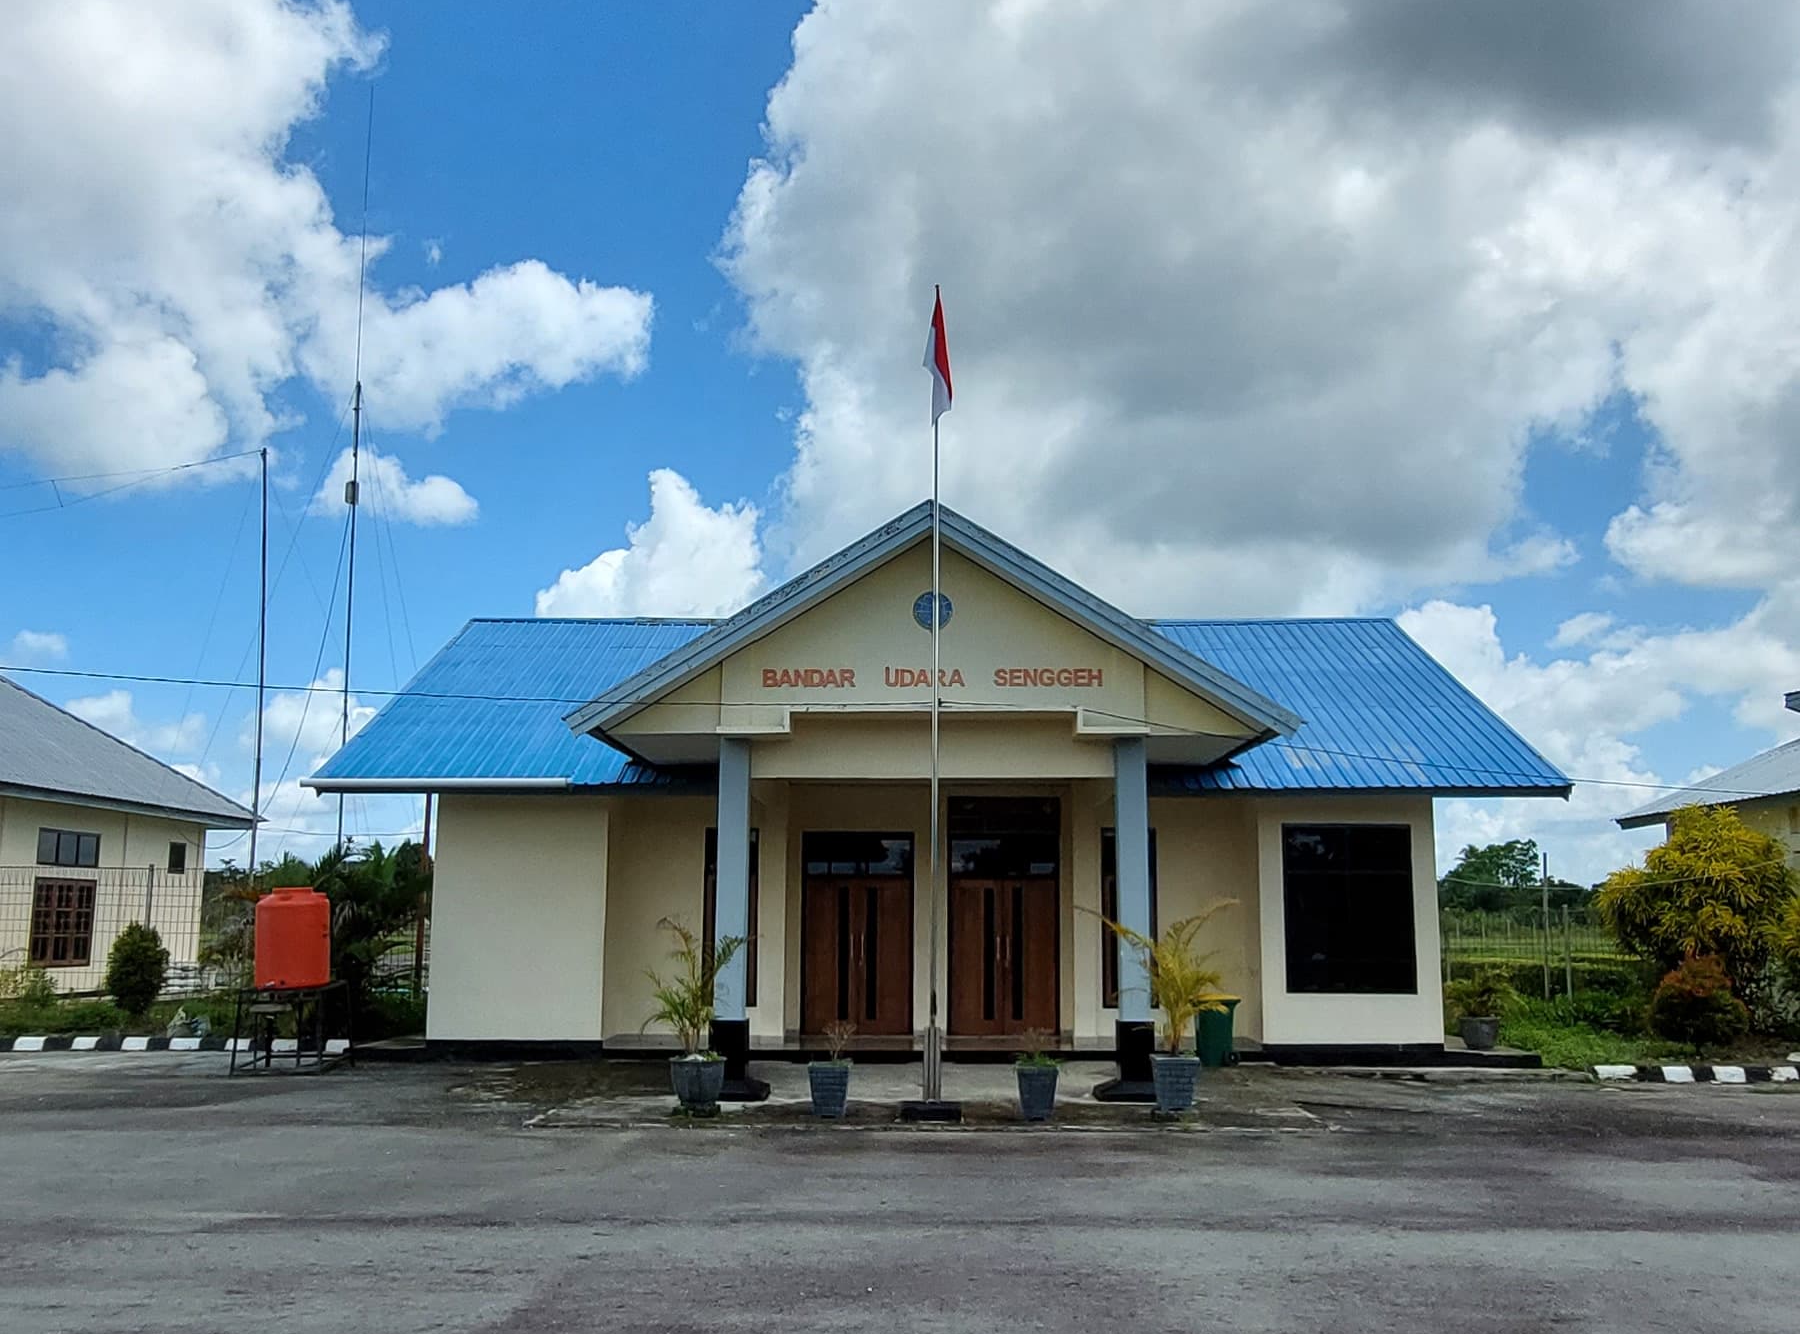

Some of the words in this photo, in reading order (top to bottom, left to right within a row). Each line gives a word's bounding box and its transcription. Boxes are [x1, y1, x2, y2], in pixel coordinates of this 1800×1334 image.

[762, 668, 856, 687] BANDAR
[885, 667, 965, 687] UDARA
[993, 668, 1103, 687] SENGGEH
